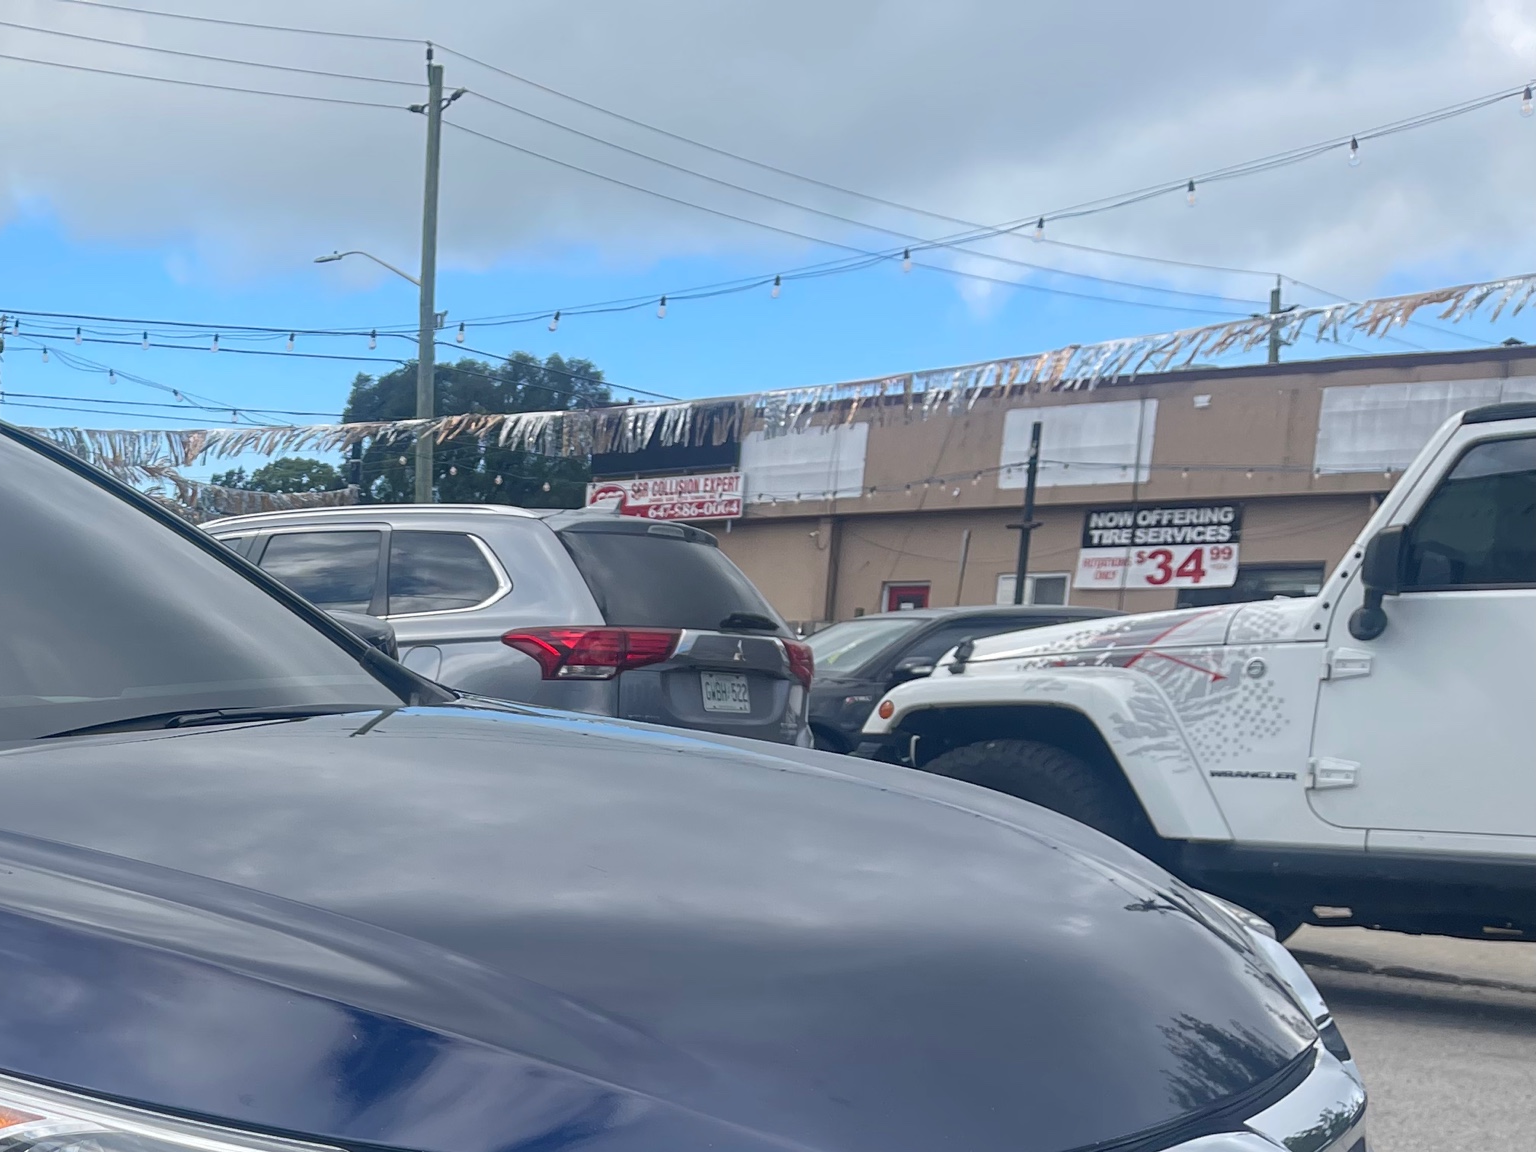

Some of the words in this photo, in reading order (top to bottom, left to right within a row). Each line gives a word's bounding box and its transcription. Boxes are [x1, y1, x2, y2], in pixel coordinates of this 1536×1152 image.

[652, 478, 700, 497] COLLISION
[703, 475, 741, 492] EXPERT
[1089, 510, 1135, 529] NOW
[1136, 506, 1235, 526] OFFERING
[1089, 528, 1132, 546] TIRE
[1133, 524, 1233, 544] SERVICES
[1209, 769, 1297, 781] WRANGLER
